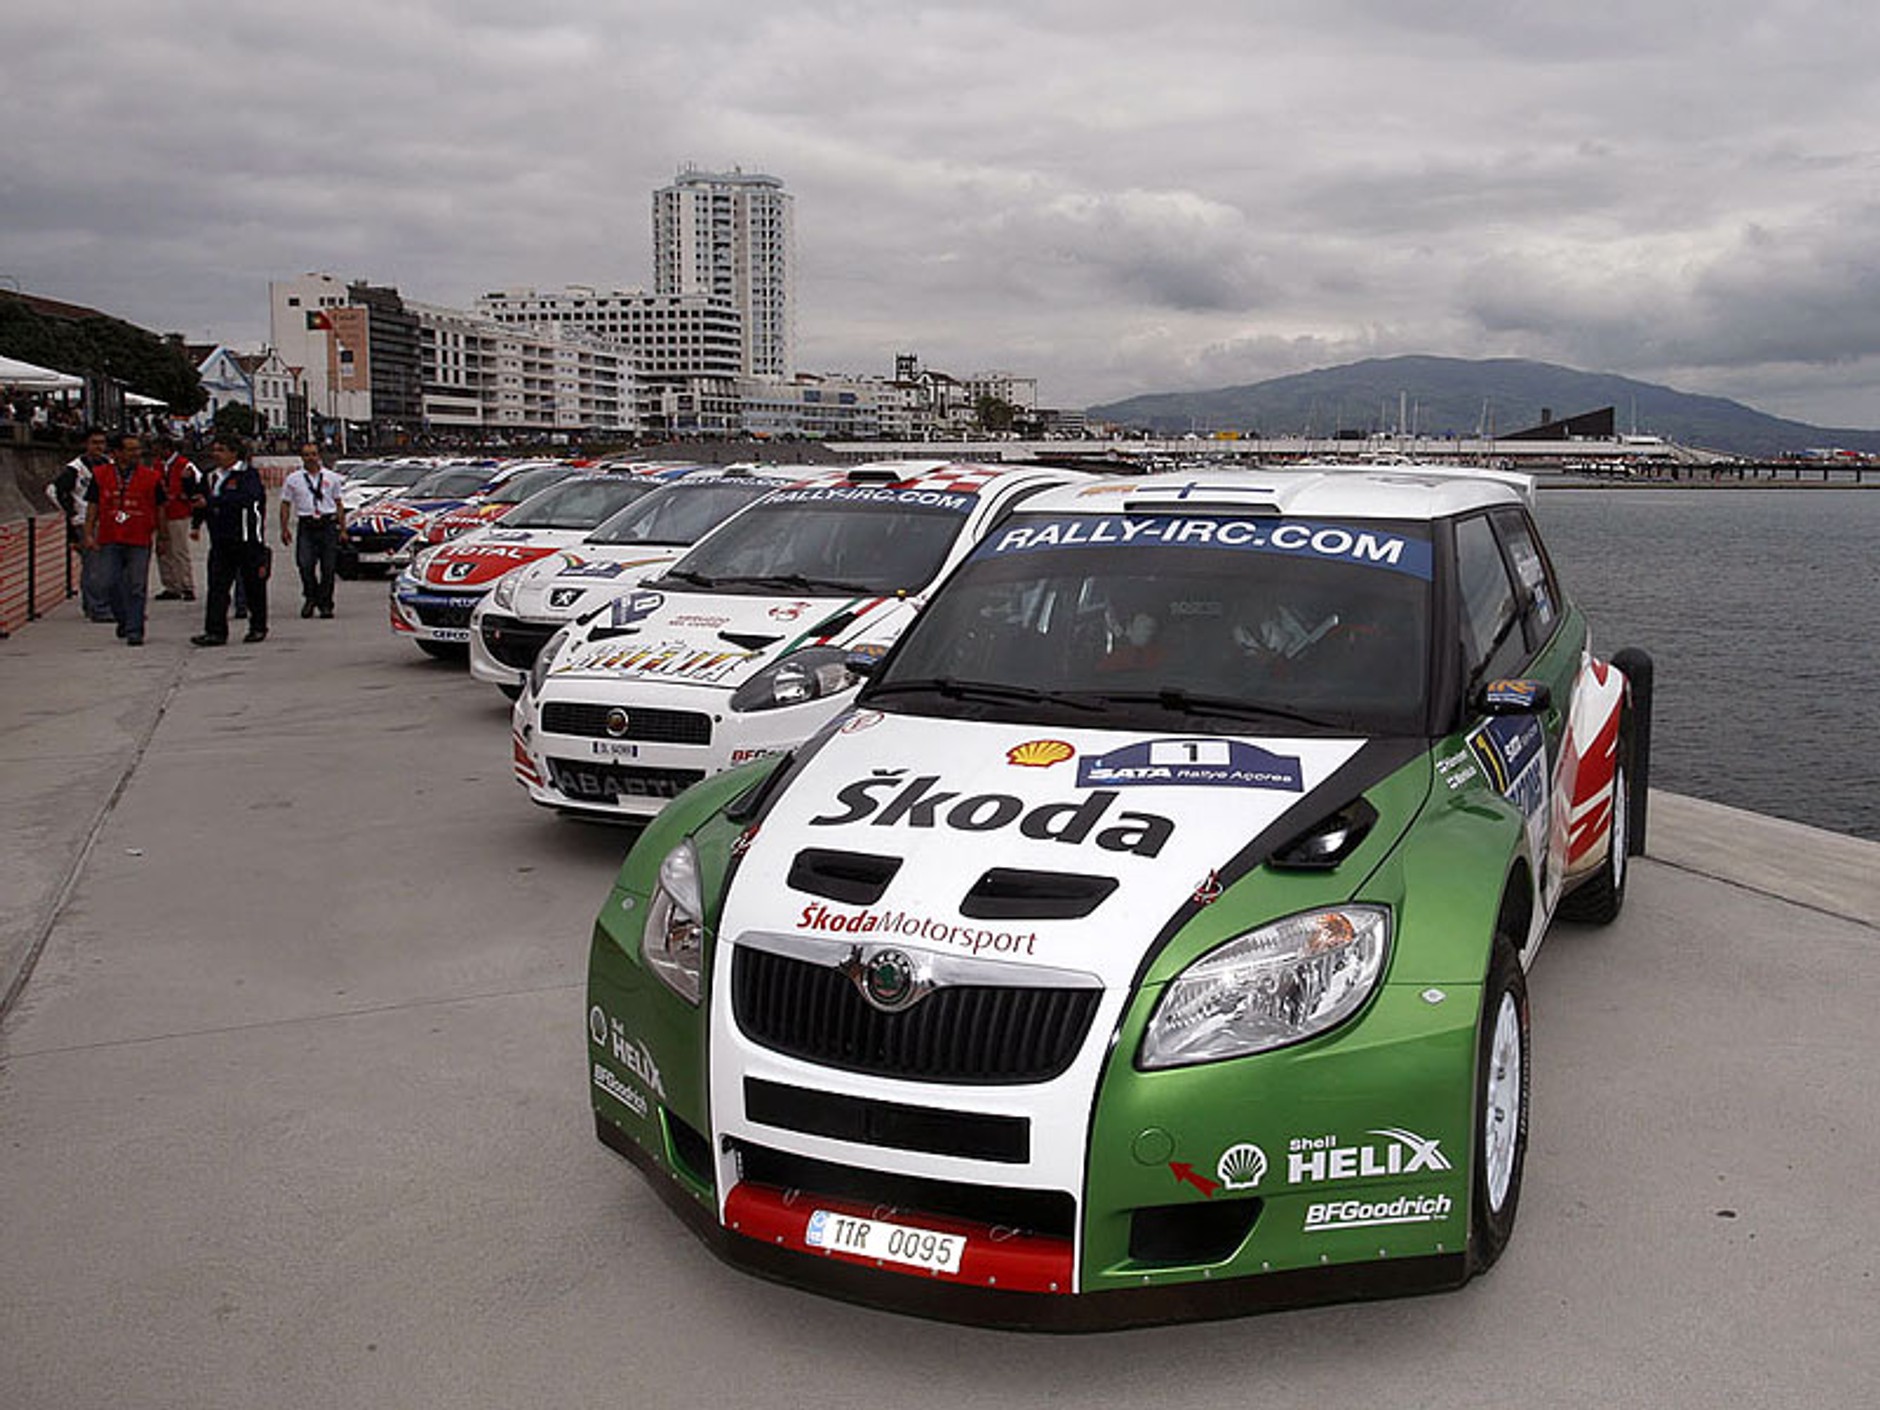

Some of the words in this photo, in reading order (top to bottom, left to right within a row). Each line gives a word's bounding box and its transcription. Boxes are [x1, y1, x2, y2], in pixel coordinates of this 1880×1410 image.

[764, 488, 968, 508] RALLY-IRC.COM
[446, 546, 522, 559] TOTAL
[996, 519, 1405, 564] RALLY-IRC.COM
[1183, 743, 1198, 763] 1
[1088, 767, 1171, 780] SATA
[1177, 769, 1228, 781] Rallye
[808, 768, 1177, 859] Škoda
[796, 901, 1038, 955] ŠkodaMotorsport
[611, 1031, 666, 1100] HELIX
[1287, 1128, 1452, 1184] HELIX
[1289, 1135, 1337, 1151] Shell
[1304, 1194, 1452, 1224] BFGoodrich
[833, 1218, 871, 1249] 11R
[888, 1228, 953, 1265] 0095
